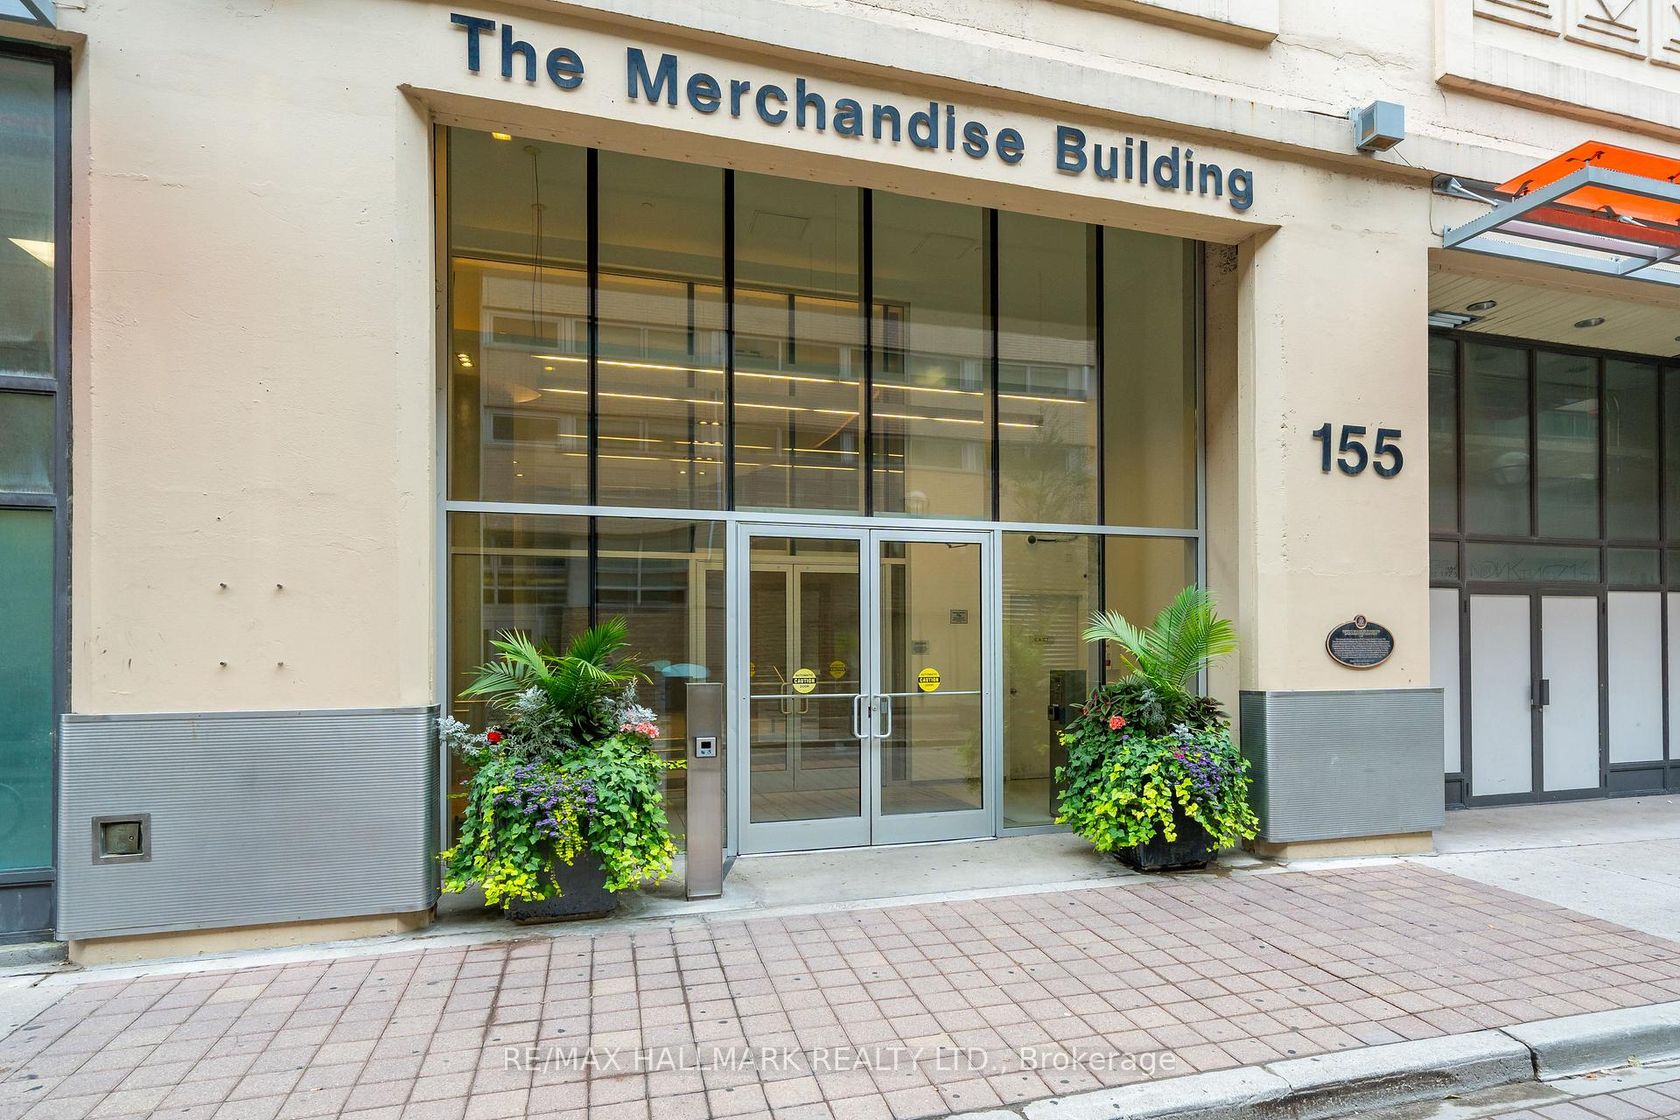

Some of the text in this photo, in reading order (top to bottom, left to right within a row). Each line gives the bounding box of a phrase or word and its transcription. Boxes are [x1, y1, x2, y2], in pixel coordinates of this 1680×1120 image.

[450, 12, 1254, 210] The Merchandise Building
[1312, 422, 1404, 477] 155
